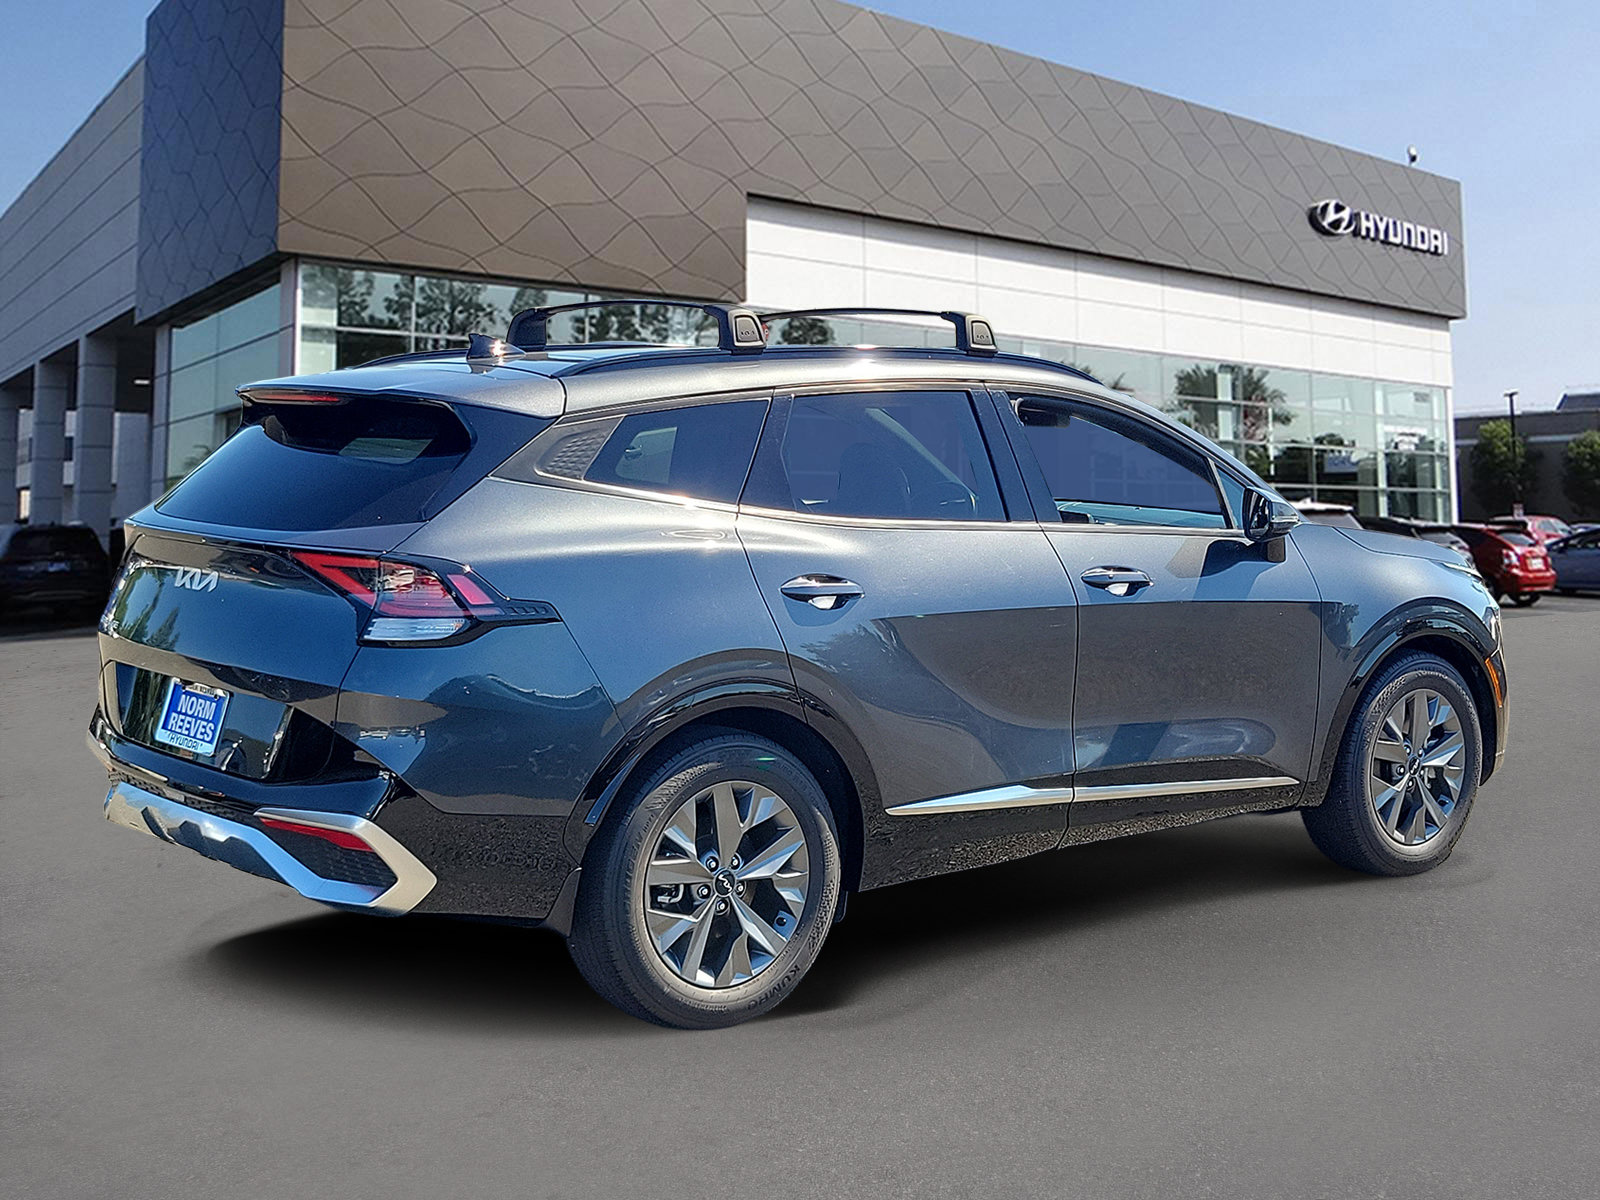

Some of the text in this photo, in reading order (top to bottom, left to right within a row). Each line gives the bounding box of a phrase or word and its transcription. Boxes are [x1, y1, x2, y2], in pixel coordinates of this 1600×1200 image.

[1361, 211, 1448, 255] HYUNDAI
[174, 567, 218, 592] KIA
[177, 694, 217, 720] NORM
[167, 712, 215, 742] REEVES
[168, 733, 201, 751] HYUNDAI
[747, 964, 801, 1010] KUMHO
